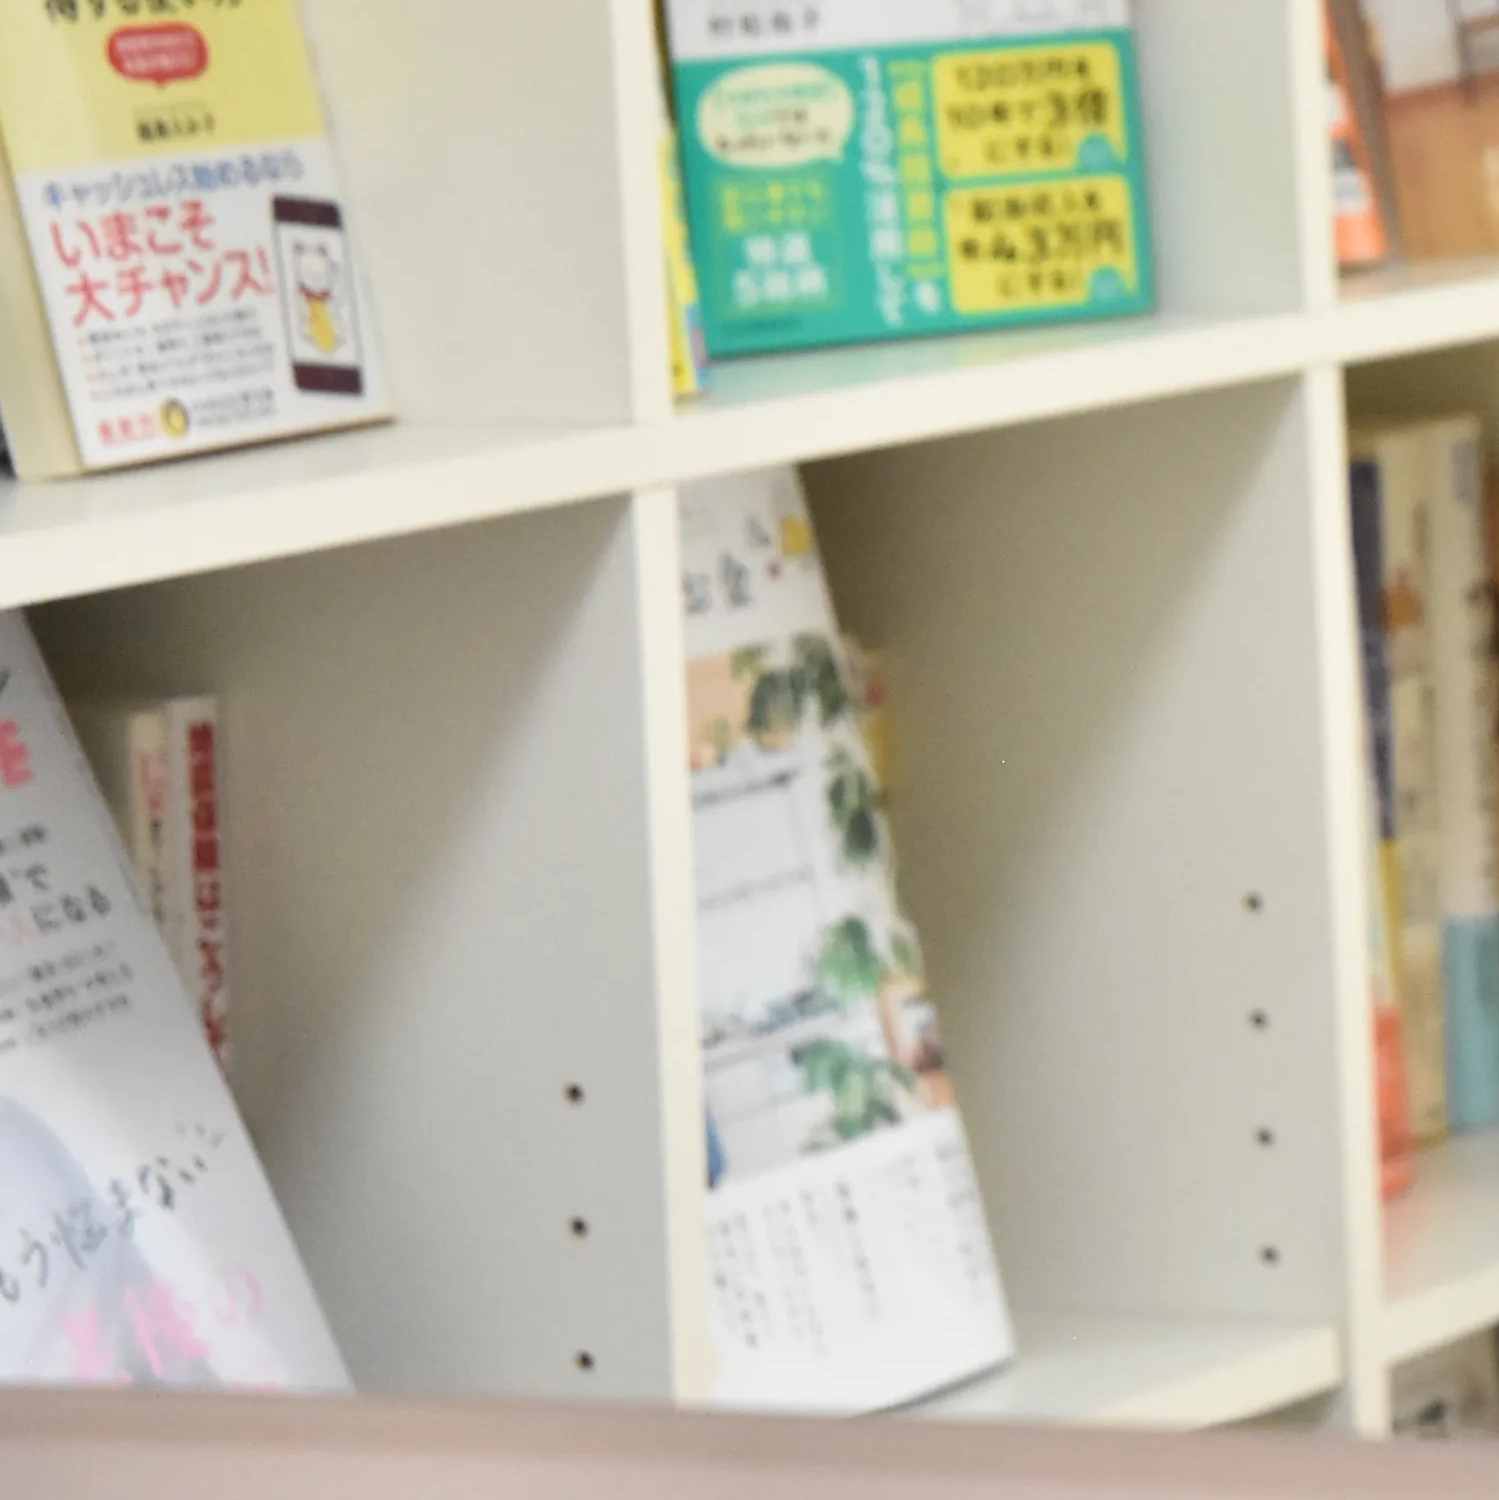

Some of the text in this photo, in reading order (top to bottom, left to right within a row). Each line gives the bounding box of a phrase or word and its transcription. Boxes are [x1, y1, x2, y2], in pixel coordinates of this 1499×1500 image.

[50, 198, 216, 268] いまこそ
[65, 247, 275, 327] 大チャンス!
